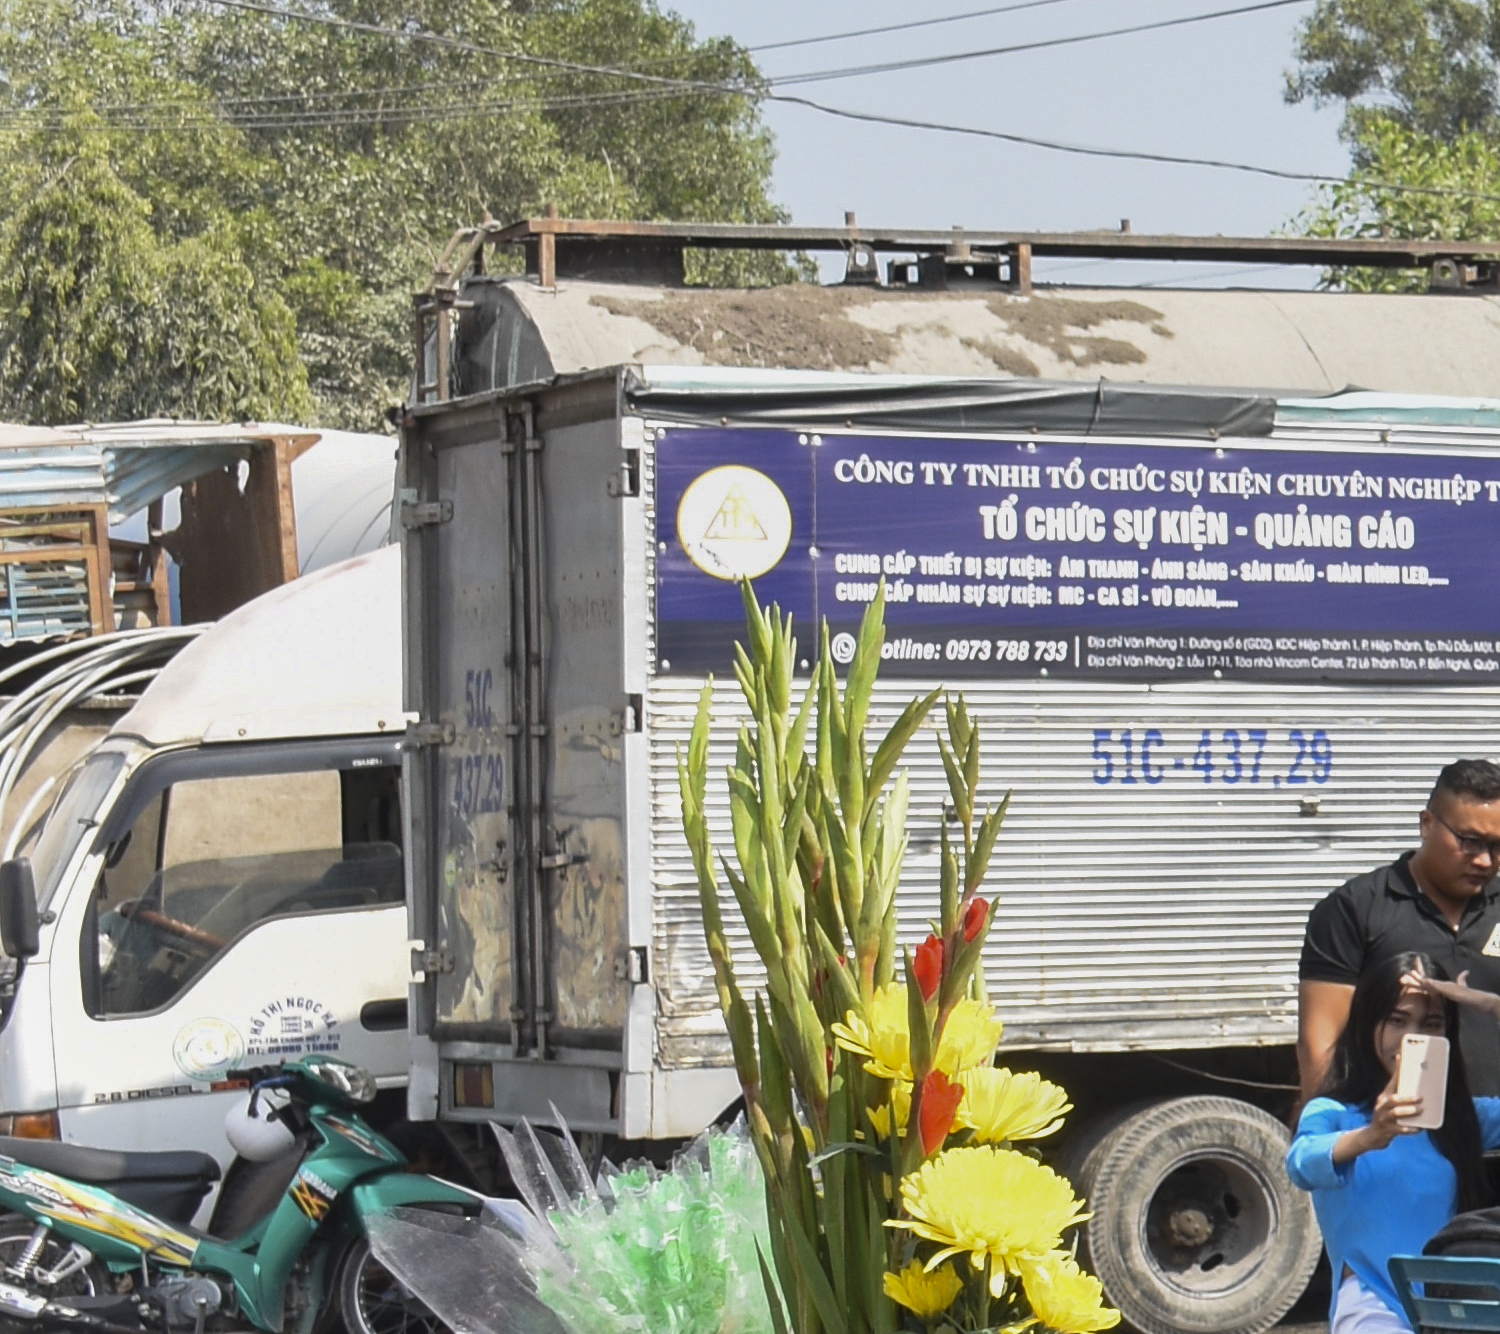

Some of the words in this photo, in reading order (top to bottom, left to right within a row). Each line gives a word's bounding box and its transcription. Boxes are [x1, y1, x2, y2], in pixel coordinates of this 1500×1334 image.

[834, 454, 914, 484] CÔNG
[920, 462, 957, 485] TY
[963, 464, 1040, 488] TNHH
[1046, 457, 1085, 489] TỔ
[1090, 463, 1166, 492] CHỨC
[1170, 468, 1203, 498] SỰ
[1209, 467, 1271, 499] KIỆN
[1277, 470, 1382, 498] CHUYÊN
[1388, 473, 1481, 505] NGHIỆP
[979, 494, 1018, 540] TỔ
[1025, 501, 1106, 541] CHỨC
[1113, 507, 1156, 549] SỰ
[1161, 505, 1228, 551] KIỆN
[1255, 504, 1352, 550] QUẢNG
[1358, 510, 1415, 549] CÁO
[835, 553, 880, 574] CUNG
[883, 549, 917, 574] CẤP
[920, 552, 962, 575] THIẾT
[984, 556, 1008, 579] SỰ
[1087, 559, 1139, 579] THANH
[884, 578, 914, 602] CẤP
[881, 638, 942, 660] otline:
[945, 639, 991, 661] 0973
[996, 639, 1030, 662] 788
[1034, 640, 1068, 662] 733
[127, 1085, 202, 1100] DIESEL
